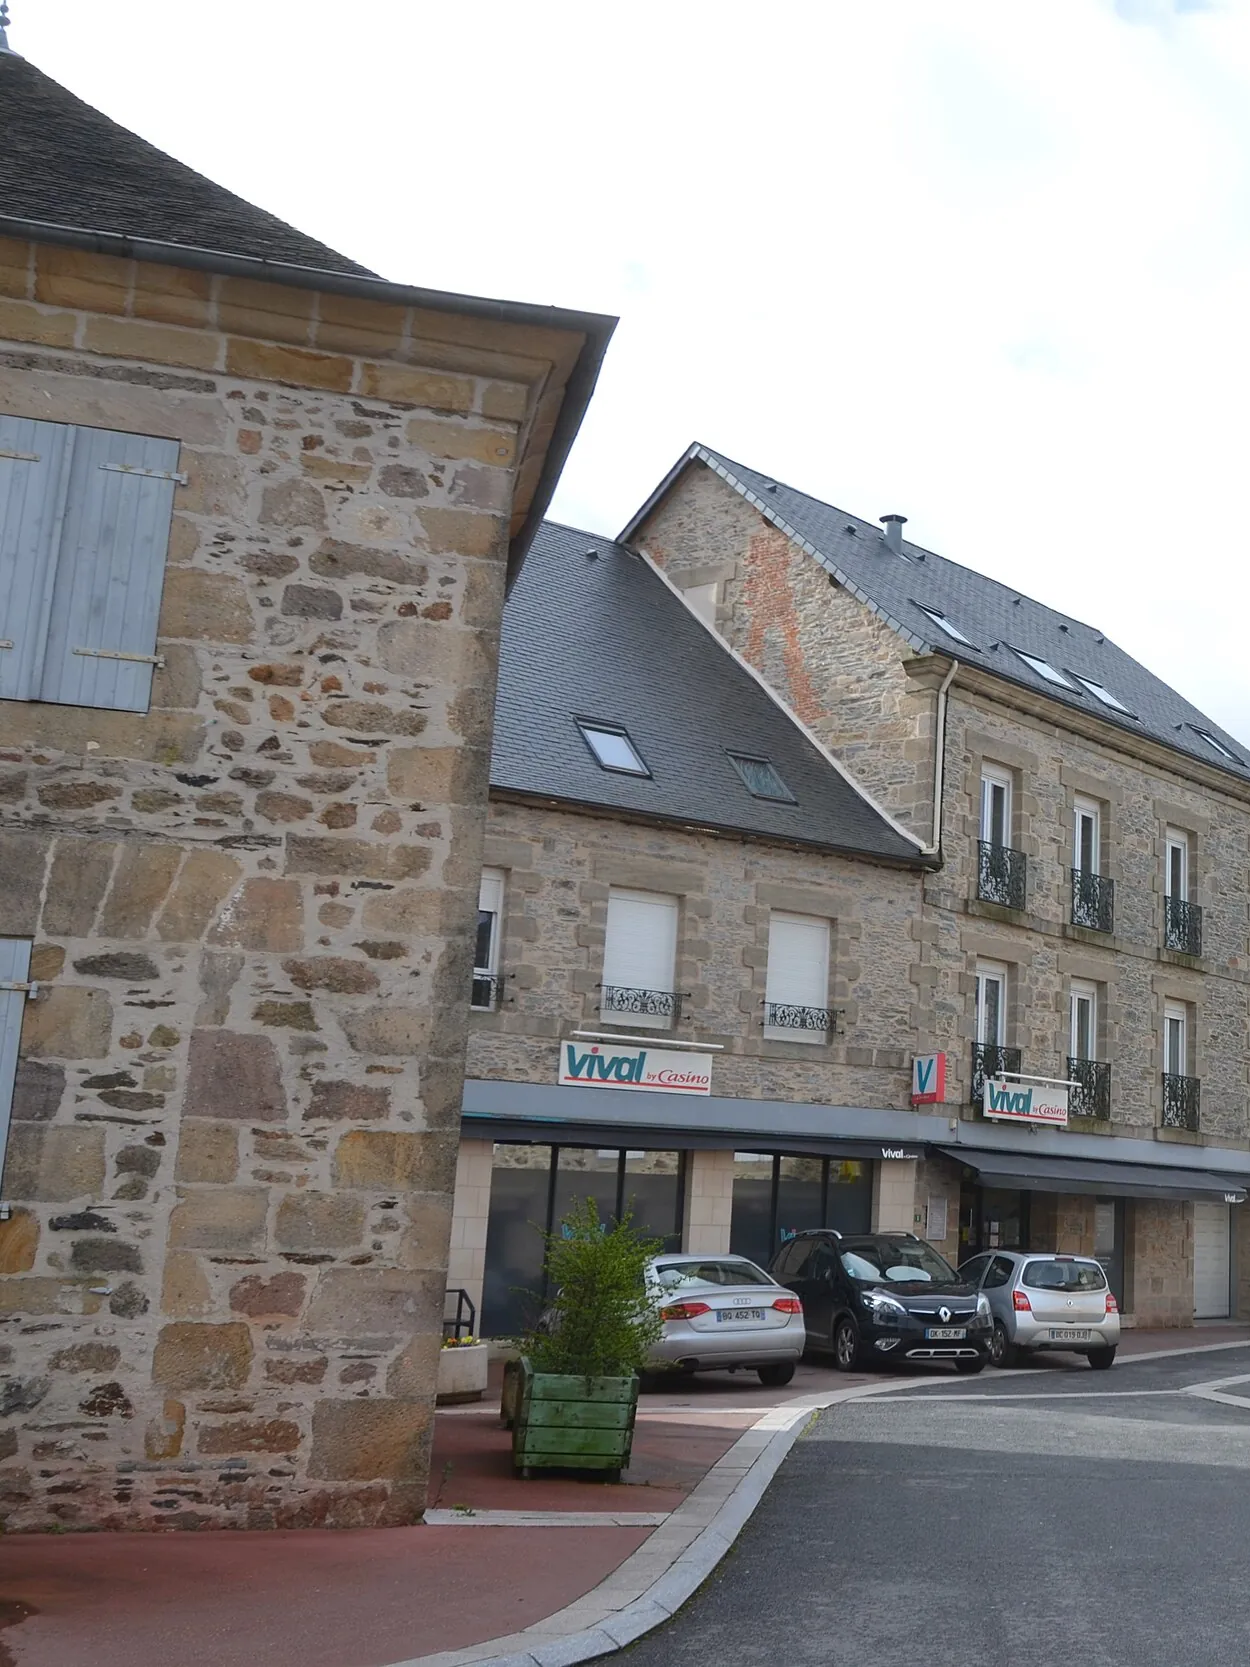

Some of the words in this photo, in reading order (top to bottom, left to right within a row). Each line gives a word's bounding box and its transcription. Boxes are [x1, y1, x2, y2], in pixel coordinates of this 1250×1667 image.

[567, 1044, 647, 1083] Vival
[647, 1073, 656, 1082] by
[657, 1069, 709, 1085] Casino
[917, 1059, 934, 1093] V
[988, 1082, 1033, 1115] Vival
[1038, 1103, 1067, 1116] Casino
[881, 1147, 904, 1159] Vival
